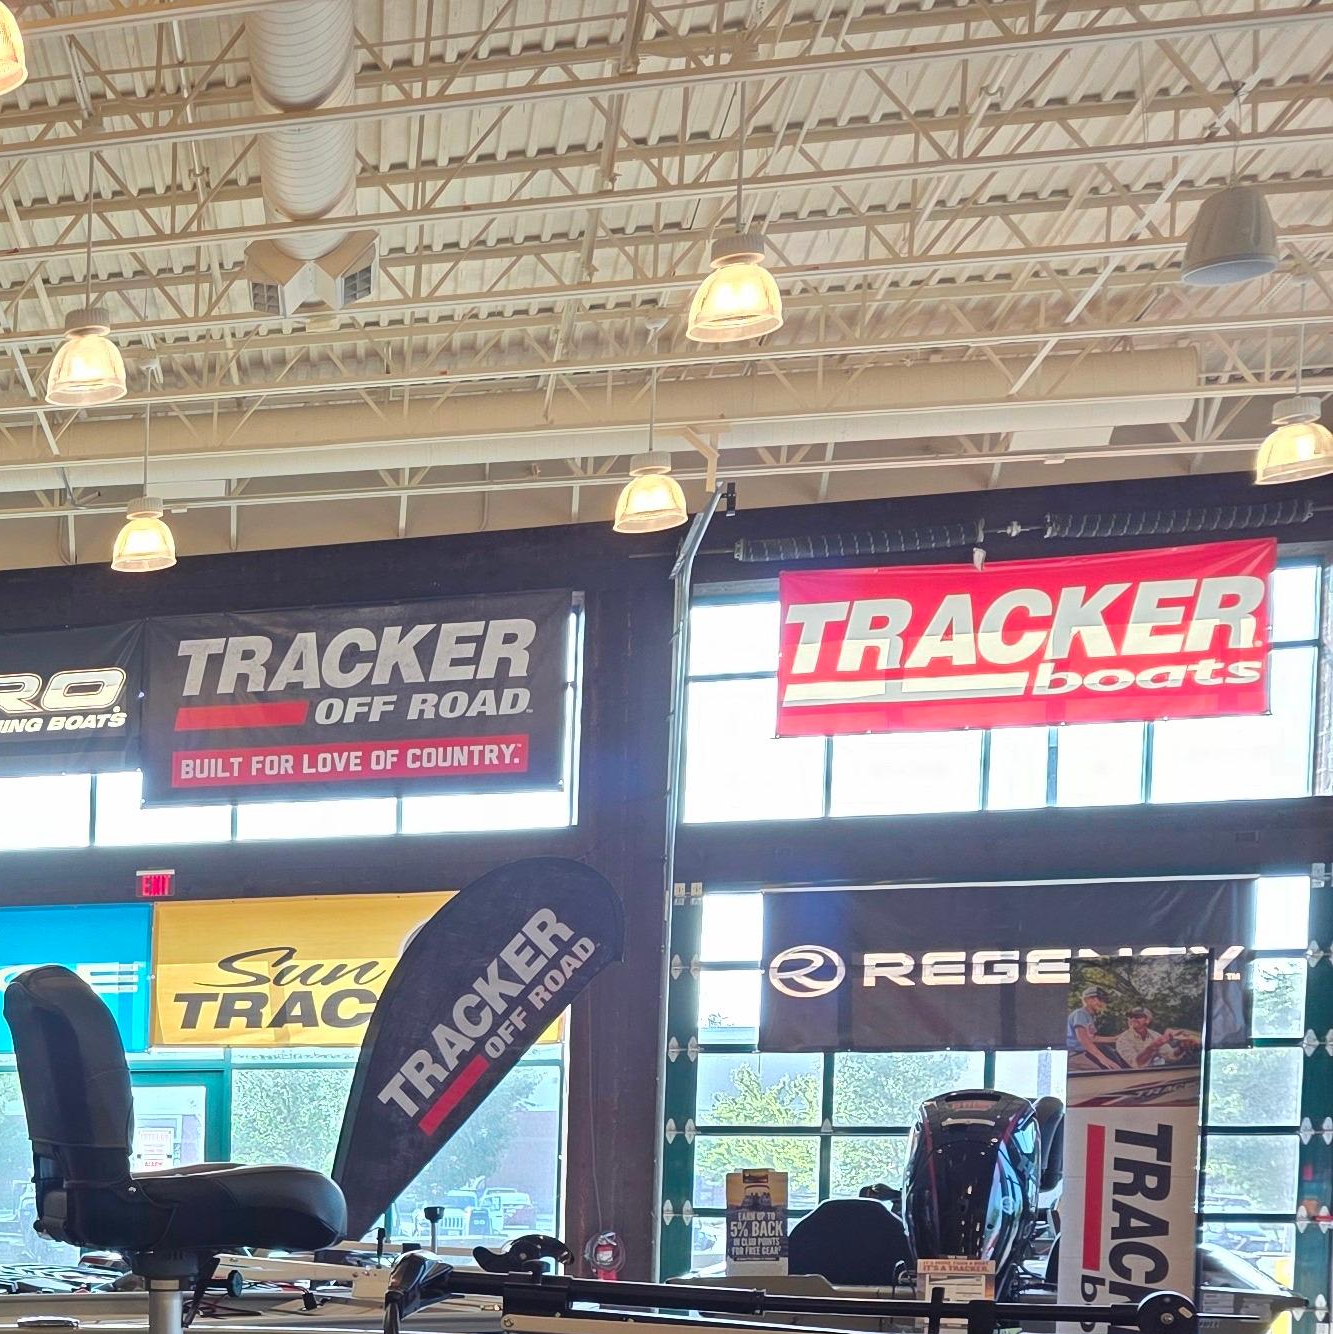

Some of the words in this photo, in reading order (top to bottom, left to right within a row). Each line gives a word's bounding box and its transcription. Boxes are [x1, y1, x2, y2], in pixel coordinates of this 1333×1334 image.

[786, 576, 1265, 674] TRACKER
[177, 618, 537, 696] TRACKER
[1033, 658, 1262, 695] boats
[47, 711, 127, 731] BOATS
[315, 694, 397, 726] OFF
[407, 688, 532, 720] ROAD
[181, 756, 243, 779] BUILT
[251, 754, 295, 776] FOR
[303, 750, 363, 773] LOVE
[371, 748, 399, 770] OF
[406, 743, 520, 768] COUNTRY.
[141, 874, 171, 896] EXIT
[193, 946, 386, 988] Sun
[862, 945, 1245, 988] REGEY
[377, 906, 575, 1118] TRACKER
[485, 1008, 529, 1059] OFF
[527, 935, 597, 1011] ROAD
[730, 1221, 748, 1237] 5%
[752, 1221, 783, 1237] BACK
[757, 1211, 765, 1221] UP
[767, 1211, 775, 1221] TO
